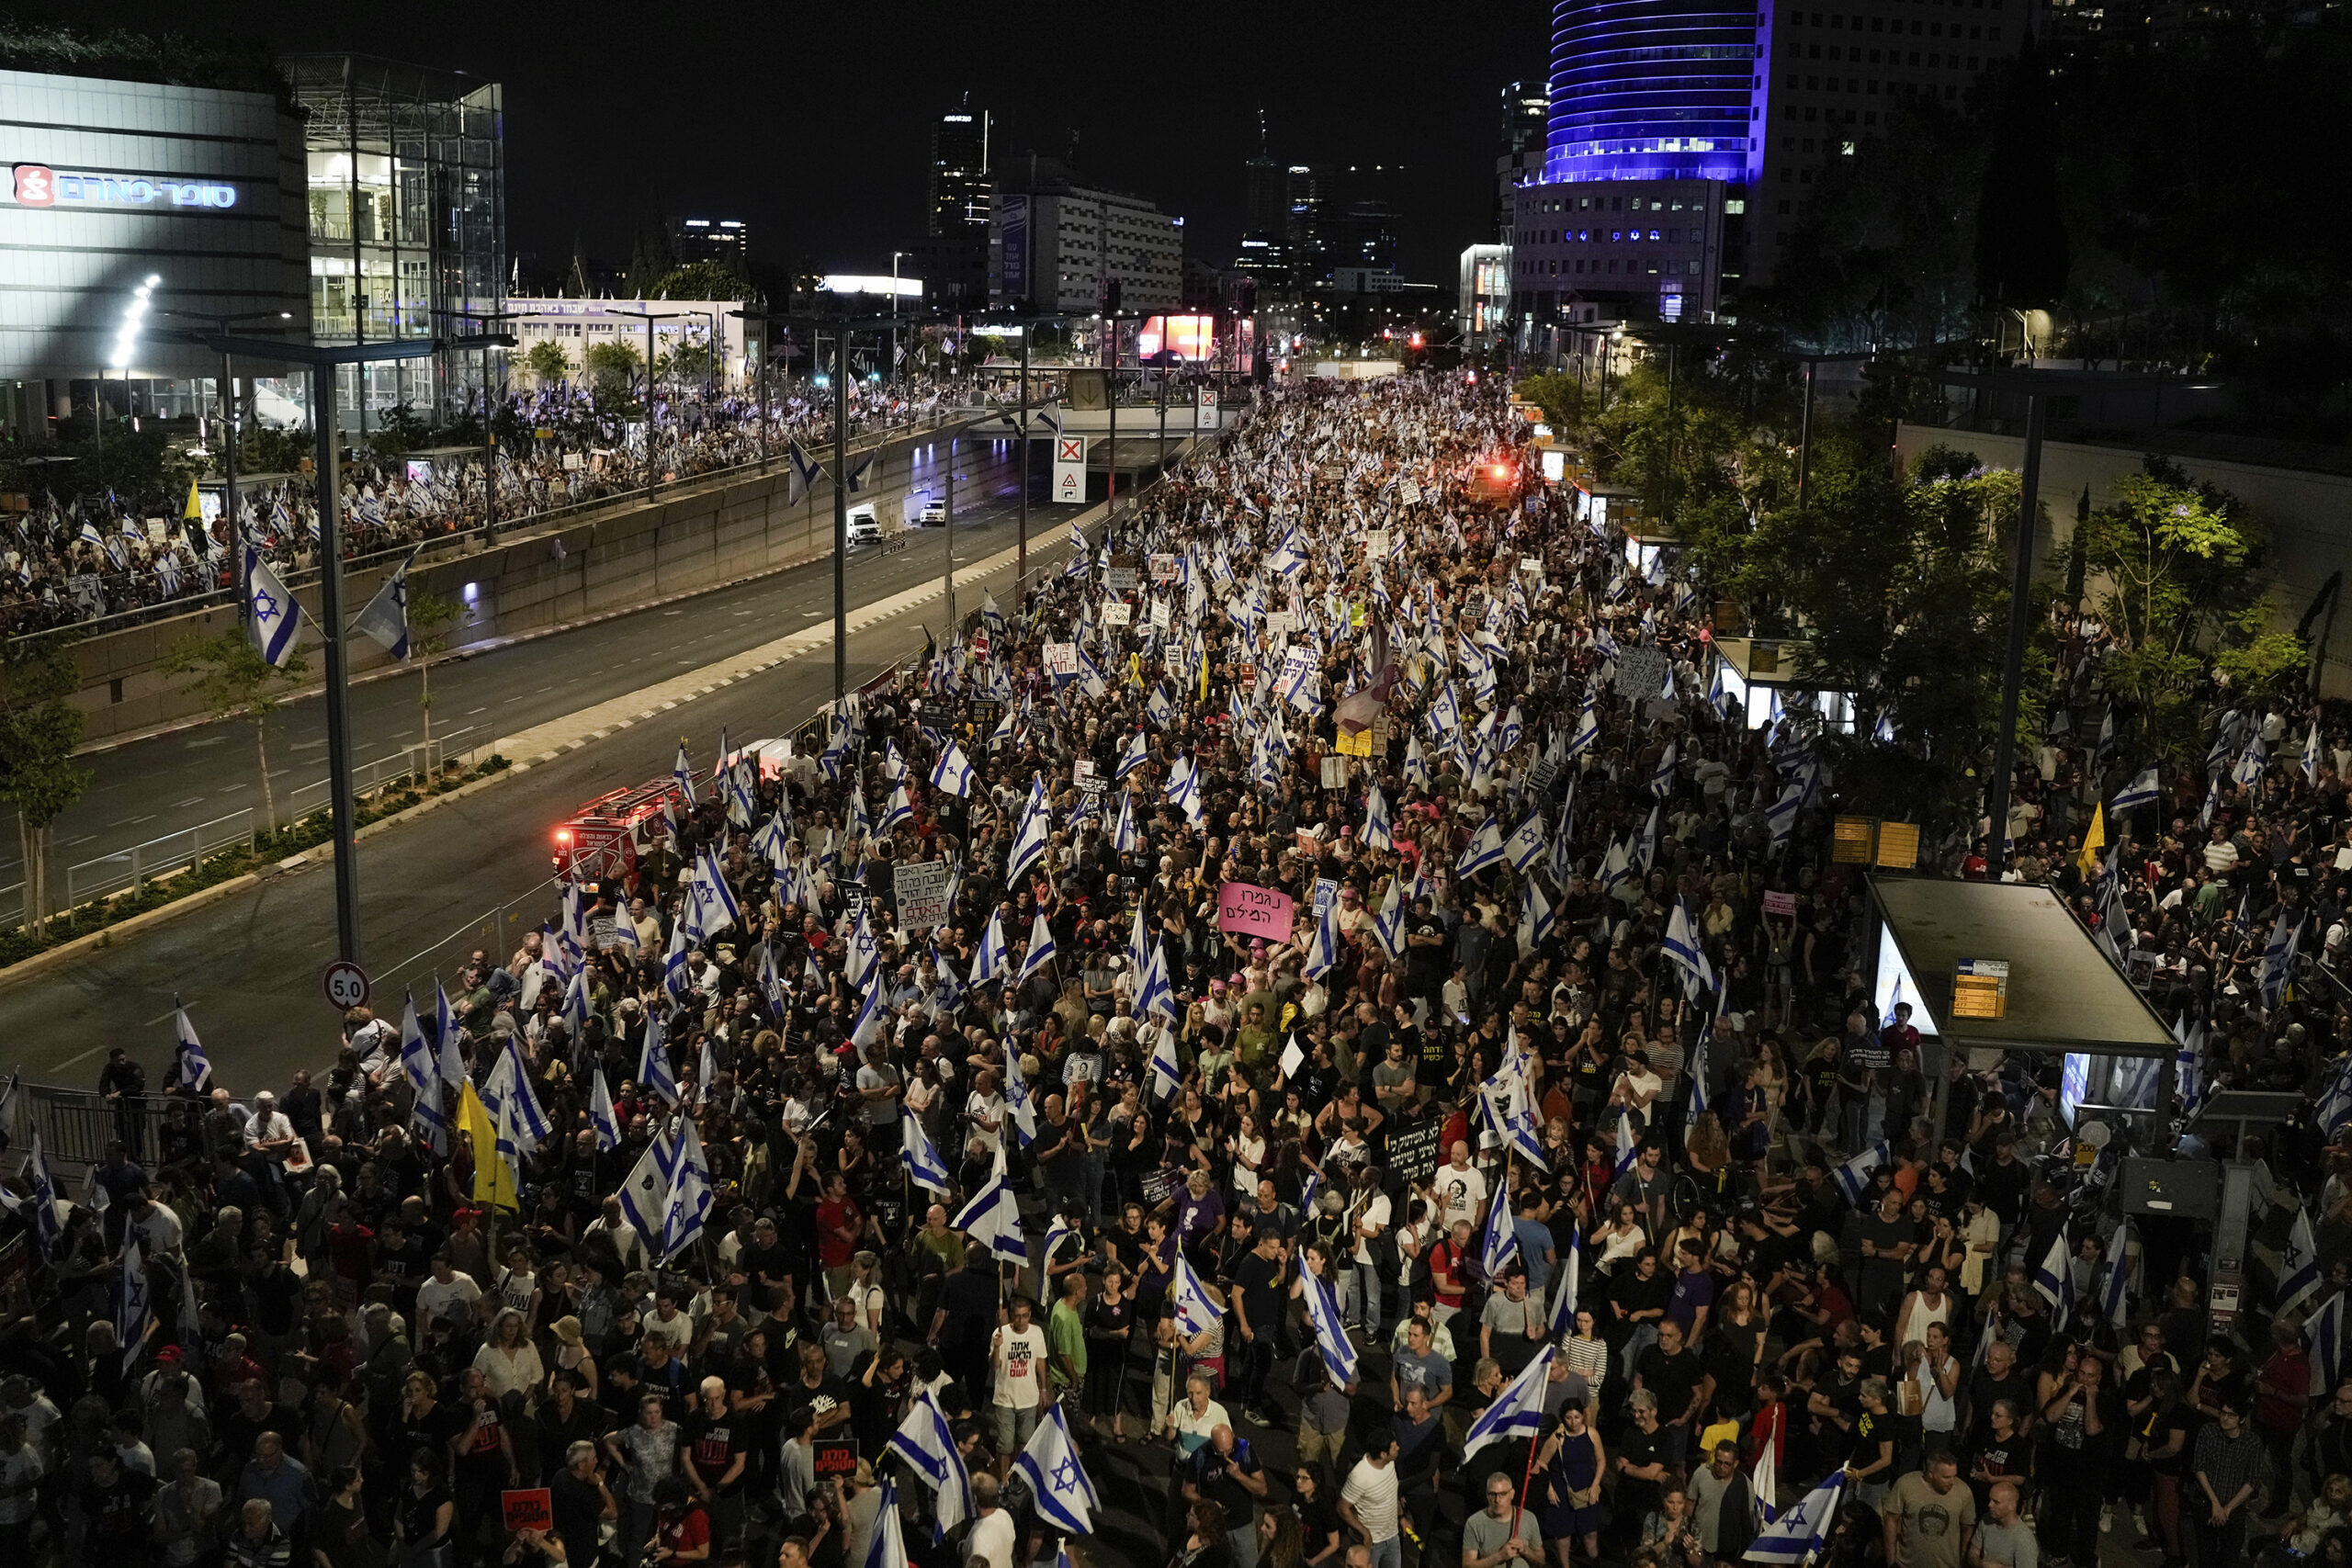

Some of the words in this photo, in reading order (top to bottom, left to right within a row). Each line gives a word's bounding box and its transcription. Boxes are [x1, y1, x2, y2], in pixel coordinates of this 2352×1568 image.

[60, 175, 236, 208] סופר-פארם
[1003, 271, 1021, 279] אחד
[1046, 645, 1057, 653] לא
[922, 863, 944, 874] ביבי
[923, 874, 944, 886] שכח
[1242, 890, 1281, 909] נגמרו
[905, 904, 942, 919] האדם
[1227, 904, 1271, 923] המילים
[334, 979, 361, 998] 5.0
[1428, 1121, 1440, 1140] לא
[1389, 1139, 1397, 1153] כי
[1419, 1142, 1436, 1159] ארצי
[2079, 1144, 2096, 1153] 200
[1389, 1149, 1416, 1169] שינתה
[1421, 1159, 1435, 1176] את
[1011, 1341, 1029, 1351] אתה
[1008, 1350, 1032, 1360] הראש
[1010, 1359, 1028, 1370] אתה
[1010, 1369, 1028, 1378] אשם
